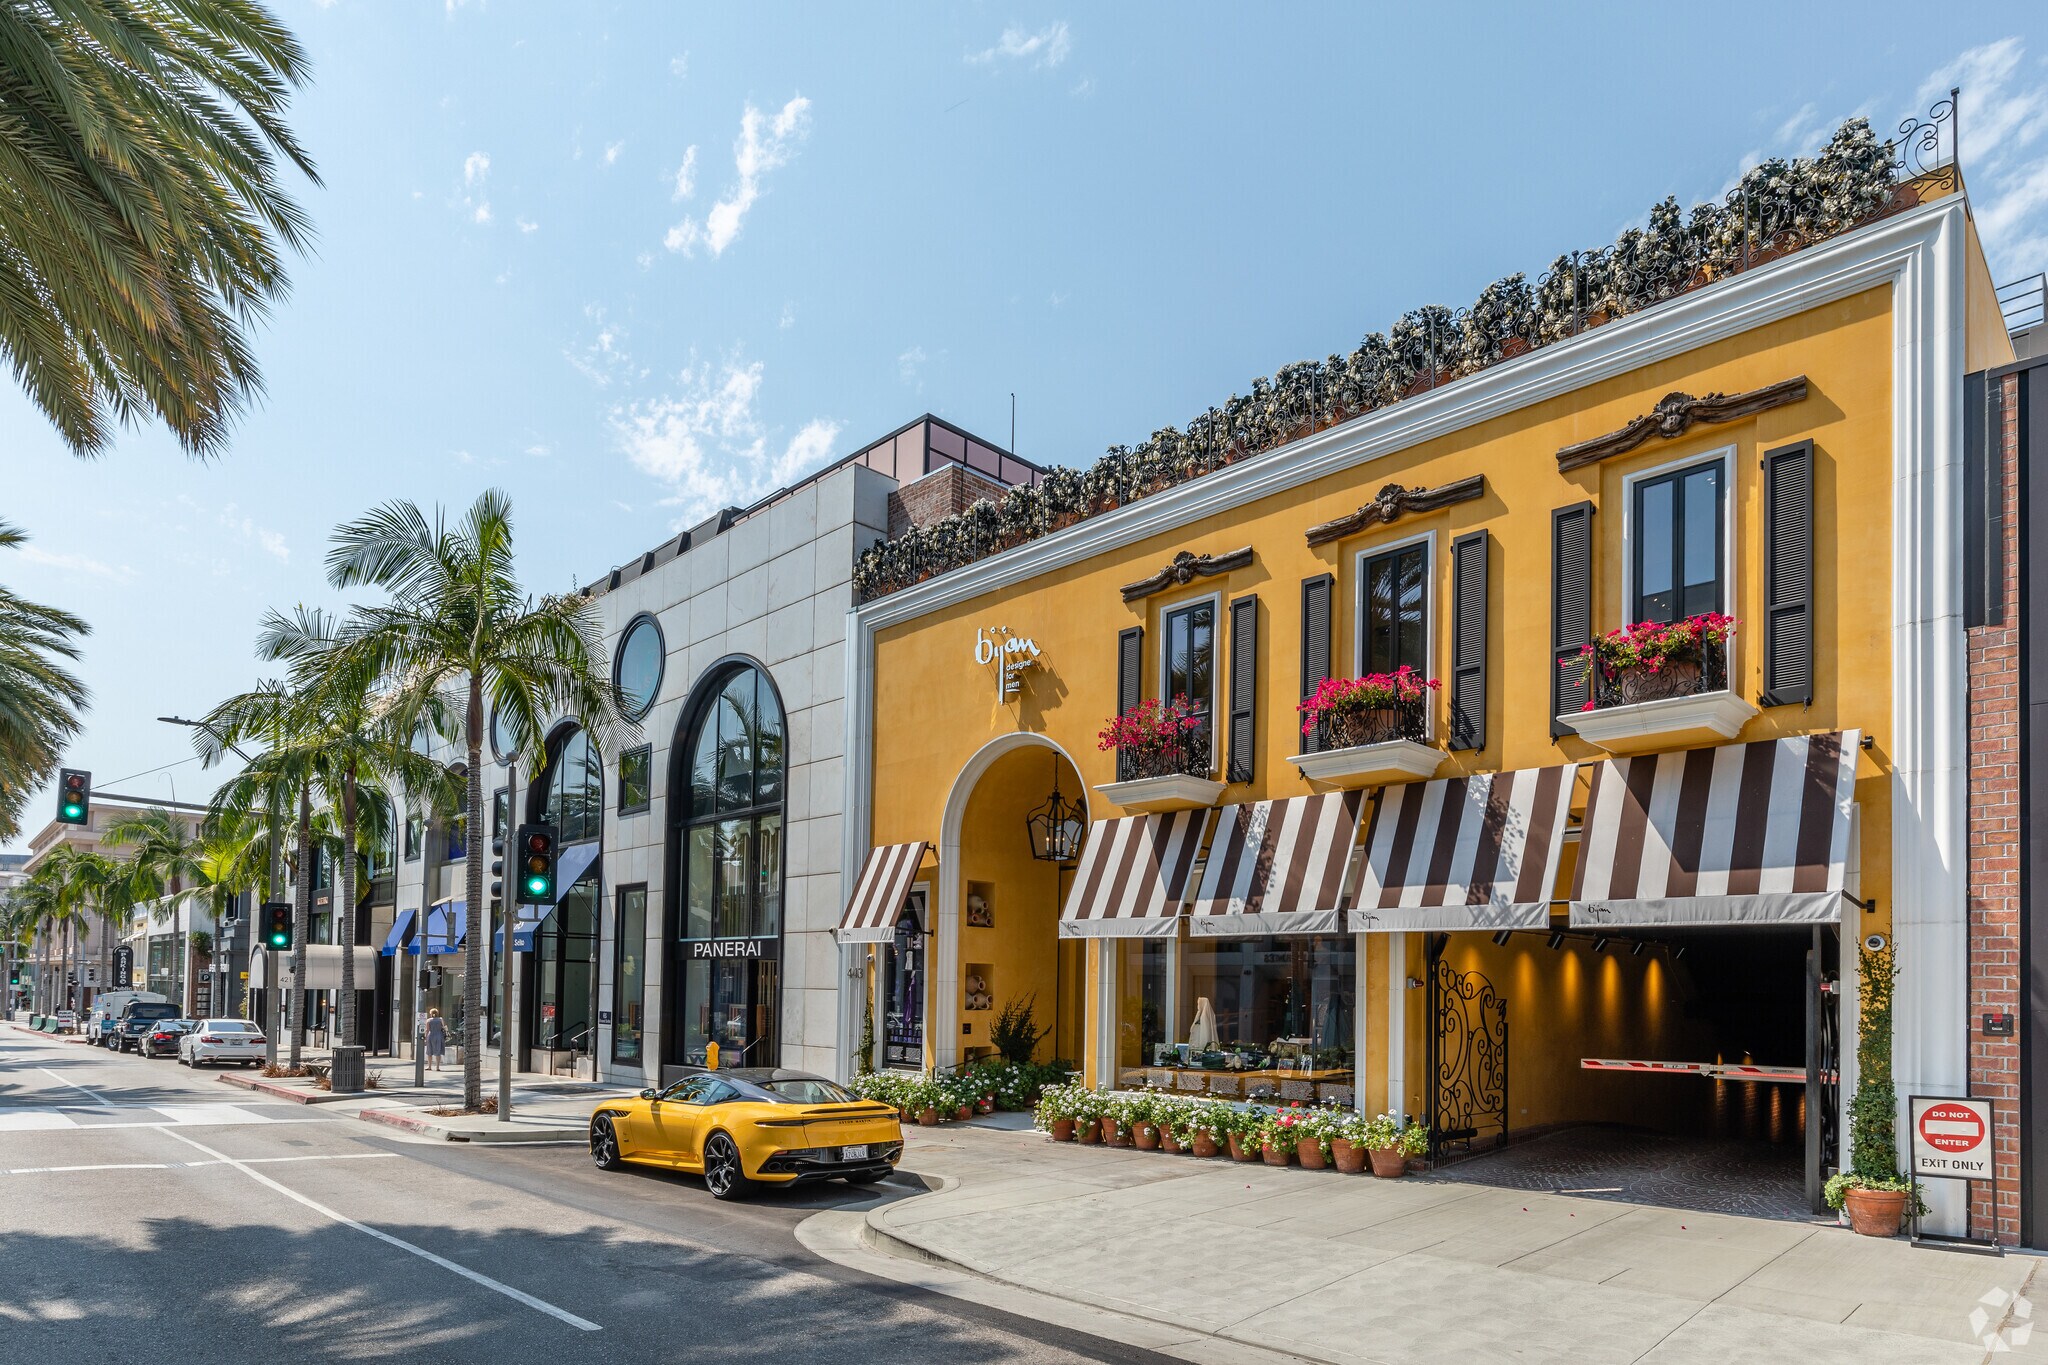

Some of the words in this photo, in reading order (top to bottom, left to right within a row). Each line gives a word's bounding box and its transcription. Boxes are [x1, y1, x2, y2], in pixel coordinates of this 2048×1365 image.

[1006, 681, 1020, 690] men
[694, 941, 761, 957] PANERAI
[847, 967, 864, 978] 443
[1935, 1138, 1970, 1147] ENTER
[1952, 1160, 1984, 1171] ONLY
